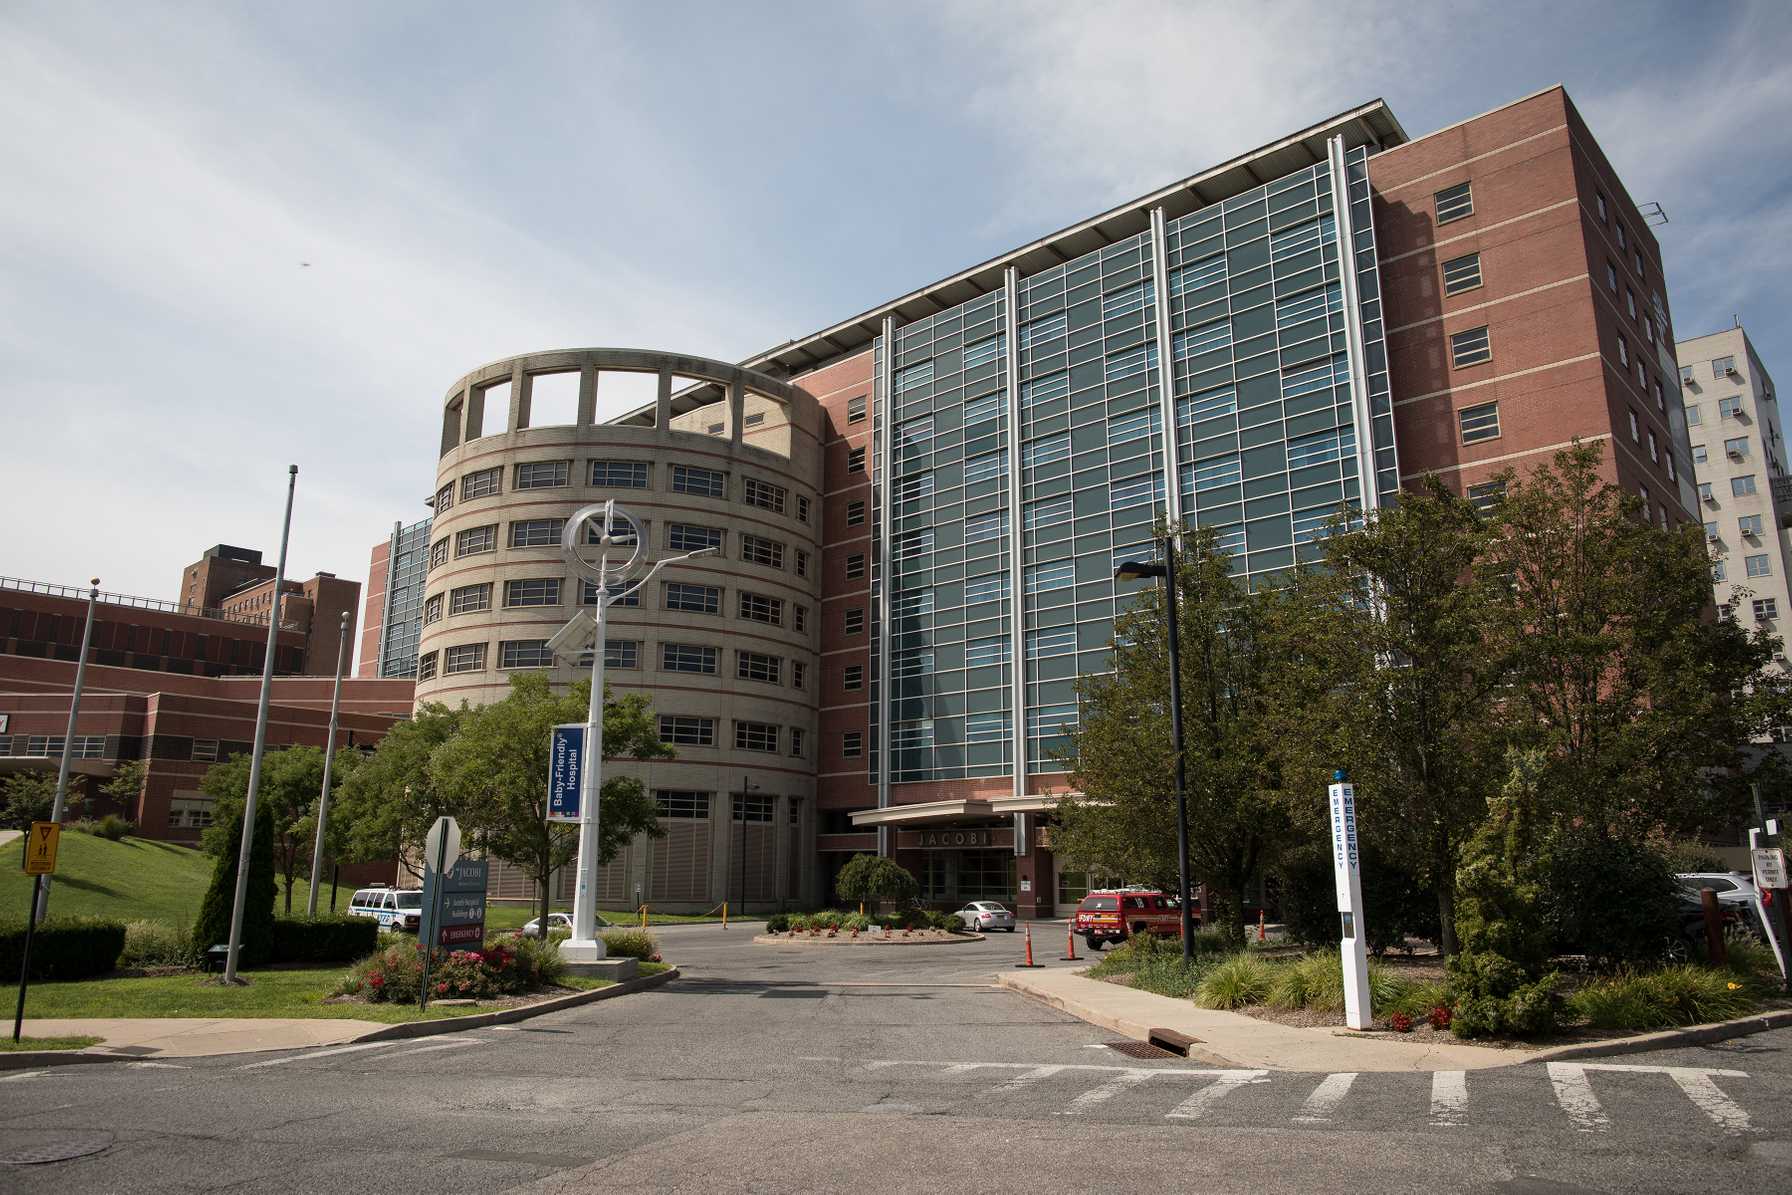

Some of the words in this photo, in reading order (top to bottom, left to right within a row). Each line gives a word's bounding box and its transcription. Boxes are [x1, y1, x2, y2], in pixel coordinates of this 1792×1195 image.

[567, 749, 578, 790] Hospital
[919, 831, 987, 846] JACOBI
[1332, 788, 1343, 869] EMERGENCY
[1343, 788, 1357, 869] EMERGENCY
